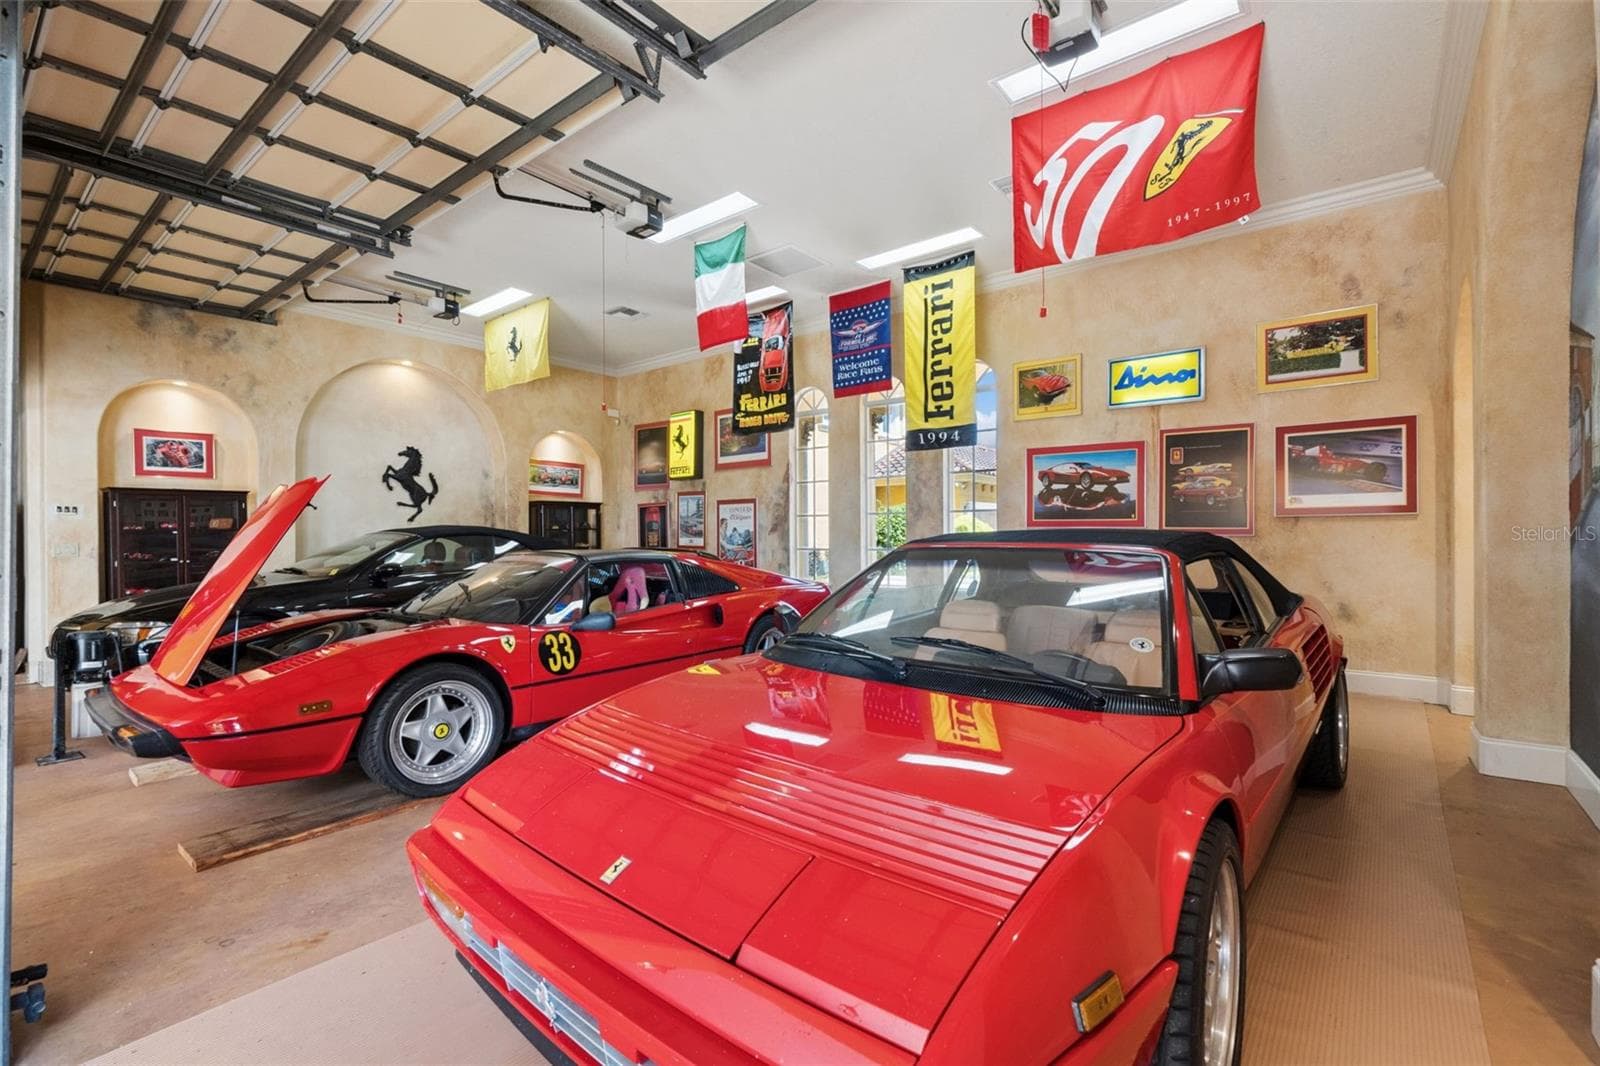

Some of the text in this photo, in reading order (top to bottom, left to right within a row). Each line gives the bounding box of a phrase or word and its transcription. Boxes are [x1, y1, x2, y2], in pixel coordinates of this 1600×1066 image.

[922, 278, 955, 423] Ferrari
[836, 365, 884, 380] Race Fans
[839, 357, 880, 372] Welcome
[1113, 364, 1197, 391] Dino
[917, 429, 961, 446] 1994
[545, 632, 575, 672] 33
